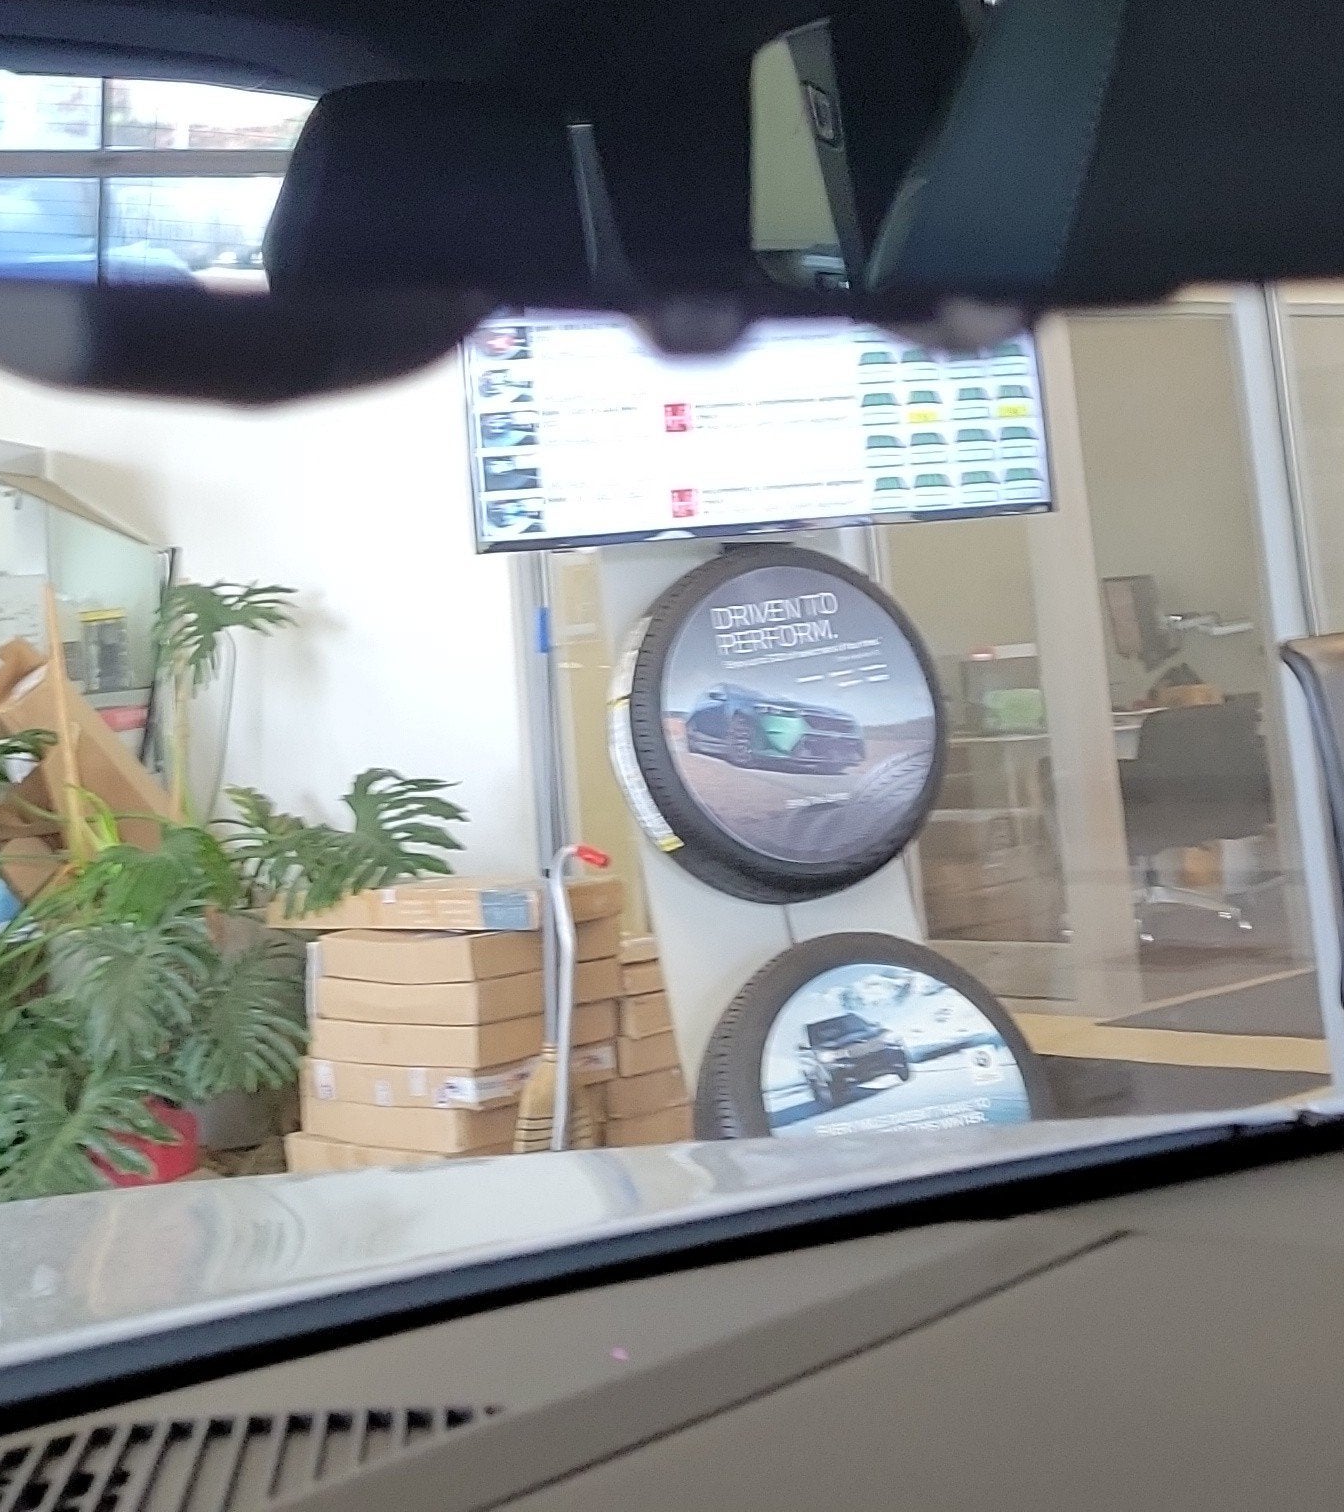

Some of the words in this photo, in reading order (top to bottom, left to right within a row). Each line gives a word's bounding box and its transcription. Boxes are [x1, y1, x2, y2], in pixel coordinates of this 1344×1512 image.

[711, 598, 801, 630] DRIVEN
[801, 592, 838, 616] TO
[716, 619, 839, 655] PERFORM.
